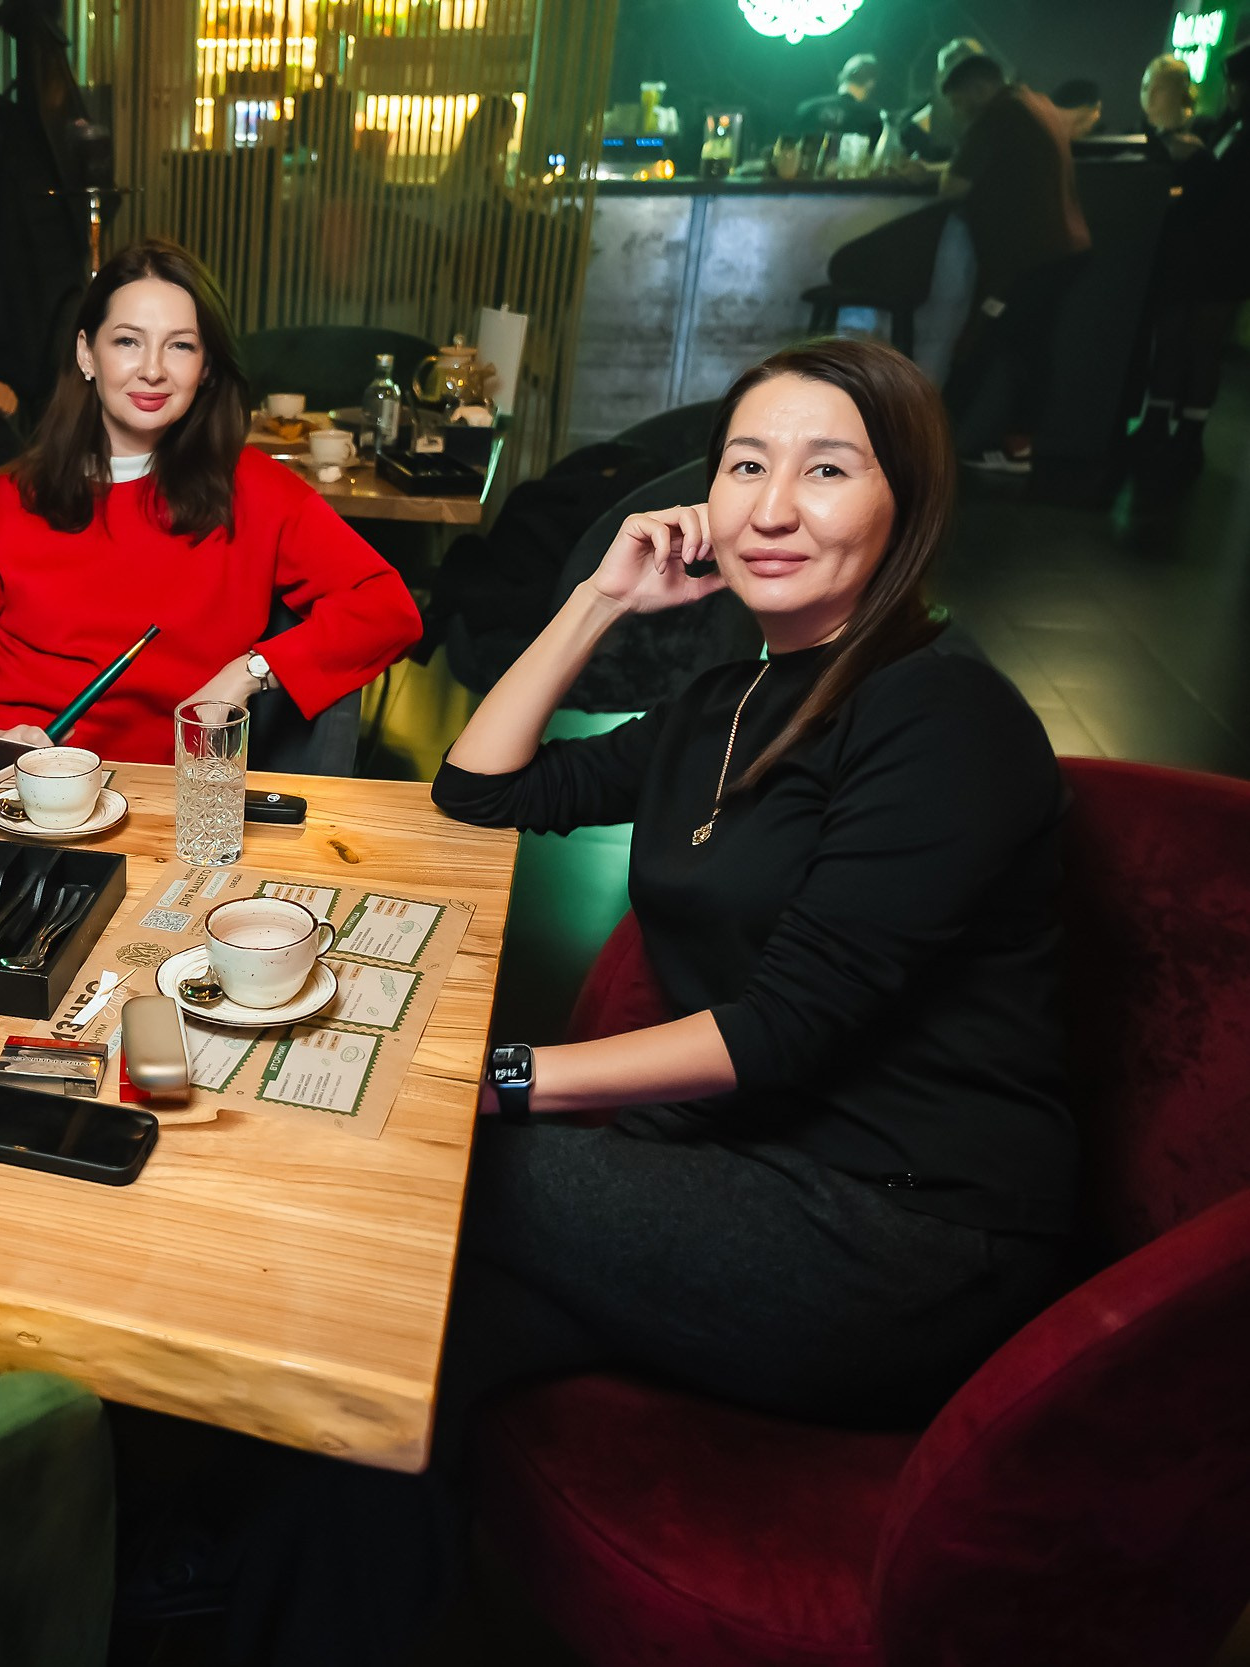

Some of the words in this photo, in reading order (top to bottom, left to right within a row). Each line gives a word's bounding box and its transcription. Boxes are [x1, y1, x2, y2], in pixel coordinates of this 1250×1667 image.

[179, 890, 194, 907] ДЛЯ
[192, 869, 212, 895] ВАШЕГО
[269, 1044, 288, 1072] ВТОРНИК
